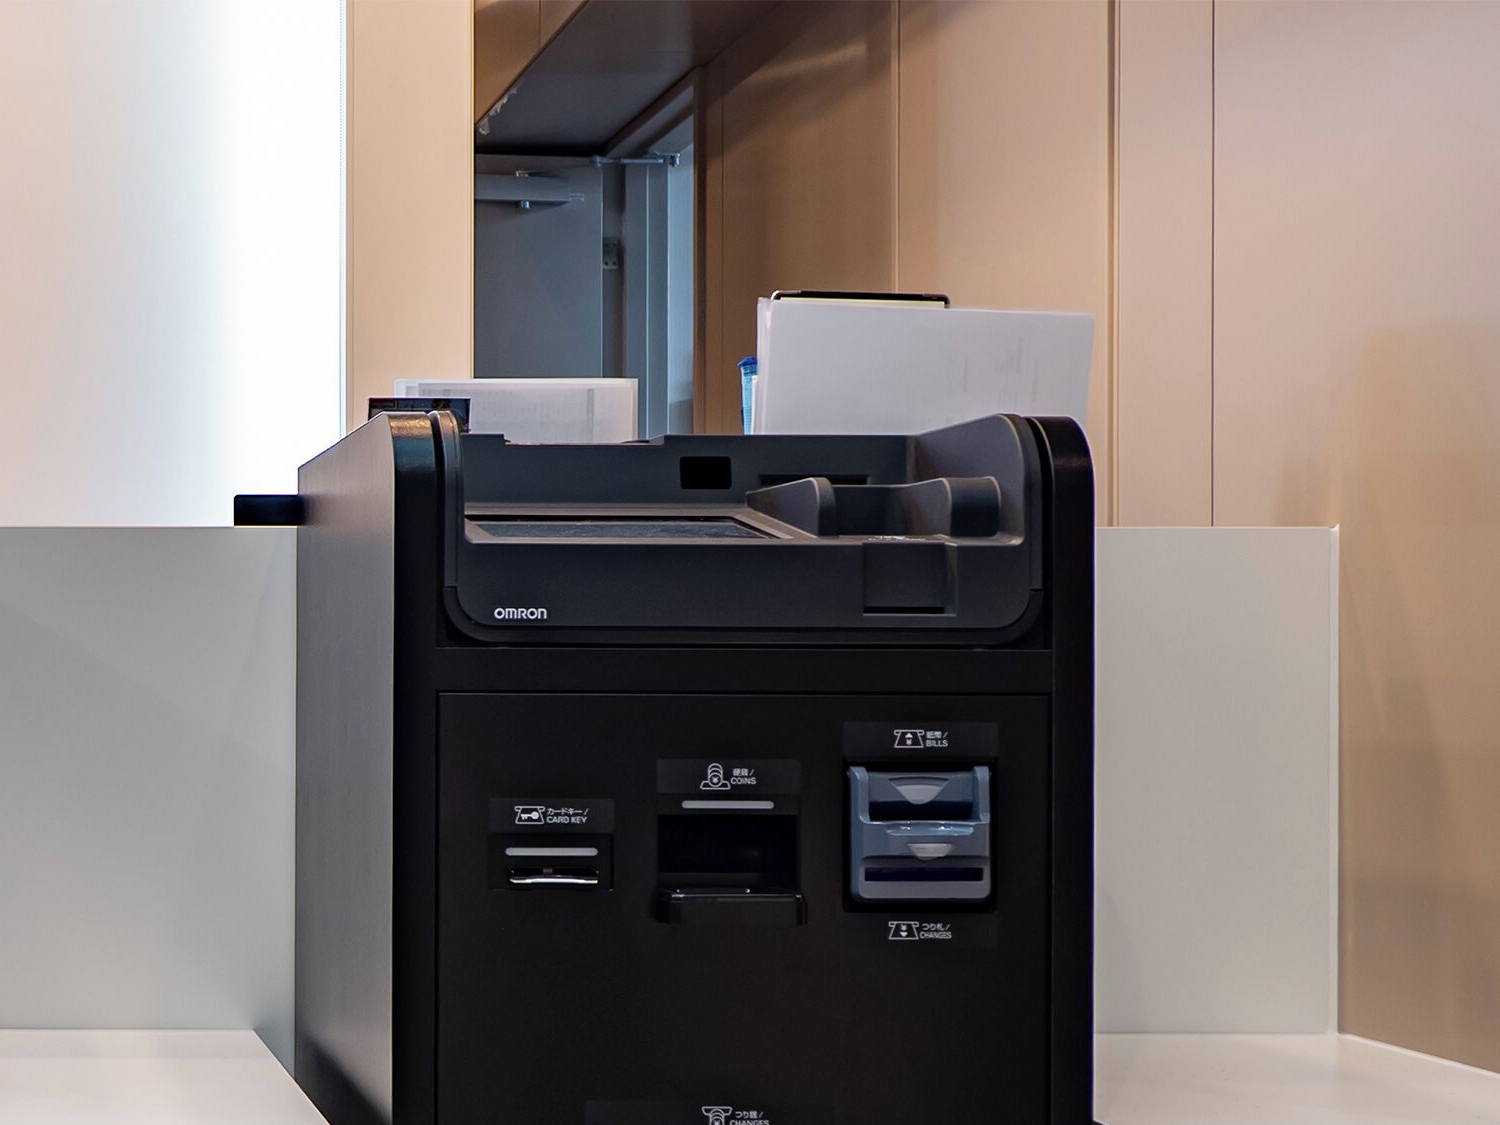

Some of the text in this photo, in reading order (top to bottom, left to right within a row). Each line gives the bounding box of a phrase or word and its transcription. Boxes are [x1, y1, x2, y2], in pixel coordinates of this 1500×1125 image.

[494, 608, 548, 619] OMRON
[925, 739, 948, 747] BILLS
[730, 777, 756, 785] COINS
[546, 816, 588, 824] CARD KEY
[920, 931, 952, 939] CHANGES
